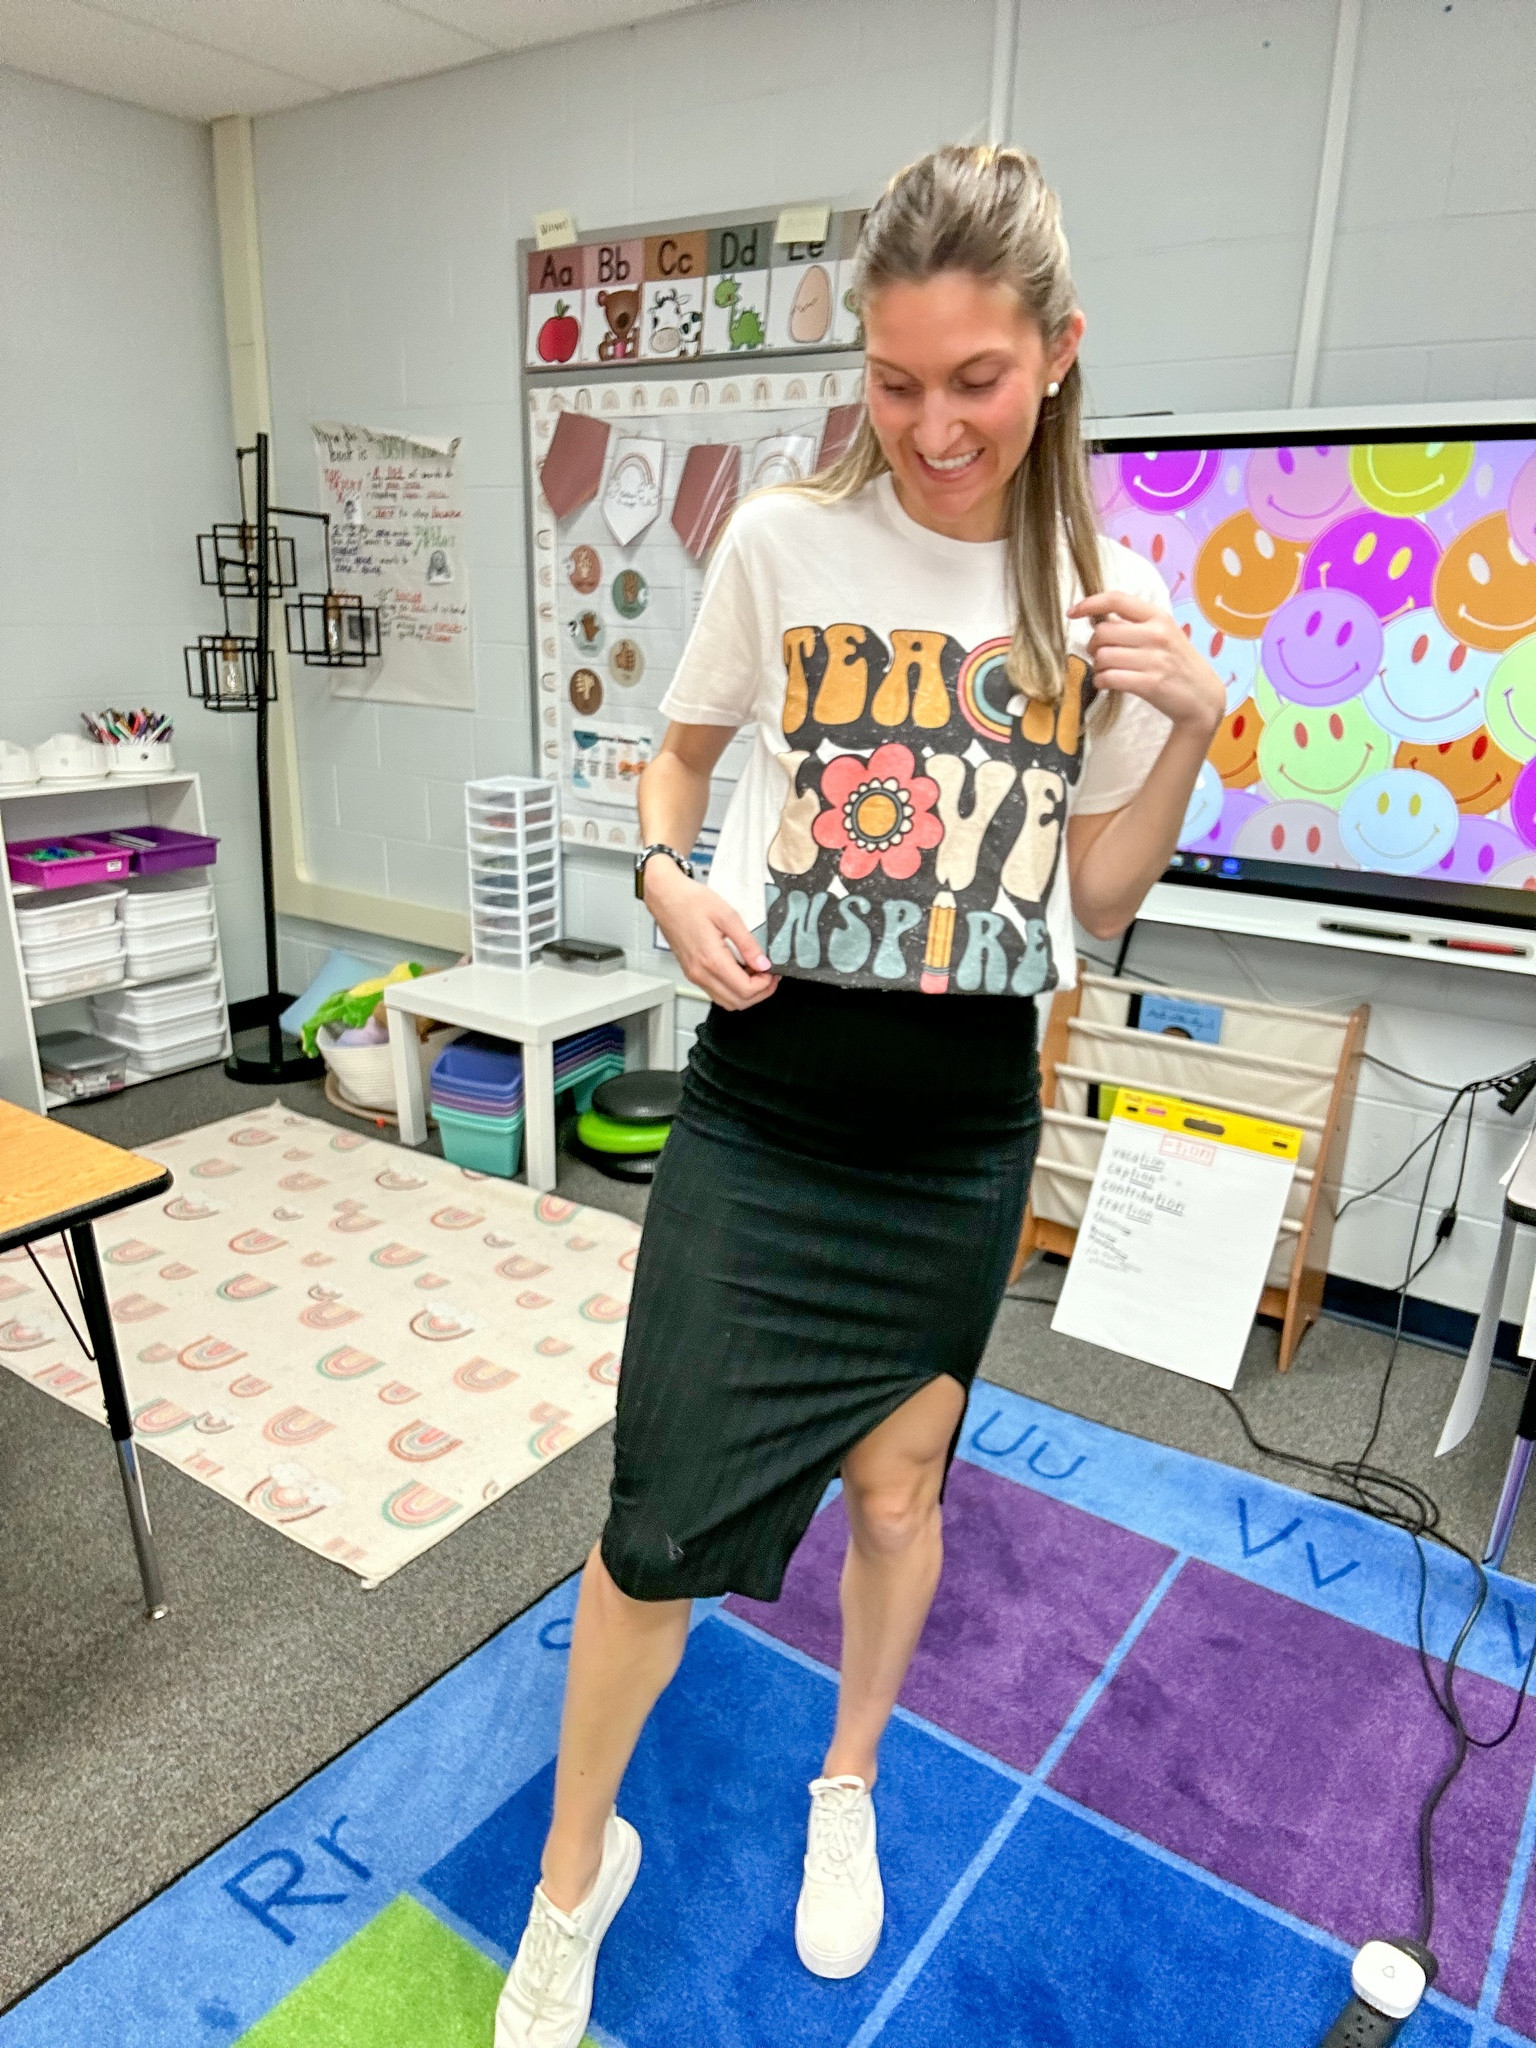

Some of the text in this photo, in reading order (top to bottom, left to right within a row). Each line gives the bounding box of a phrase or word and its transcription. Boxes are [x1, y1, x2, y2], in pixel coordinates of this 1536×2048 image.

[540, 254, 573, 289] Aa
[599, 247, 631, 283] Bb
[656, 239, 694, 276] Cc
[719, 228, 759, 269] Dd
[765, 883, 1050, 995] NSPIRE
[971, 1410, 1087, 1480] Uu
[1237, 1496, 1361, 1589] Vv
[221, 1815, 373, 1947] Rr
